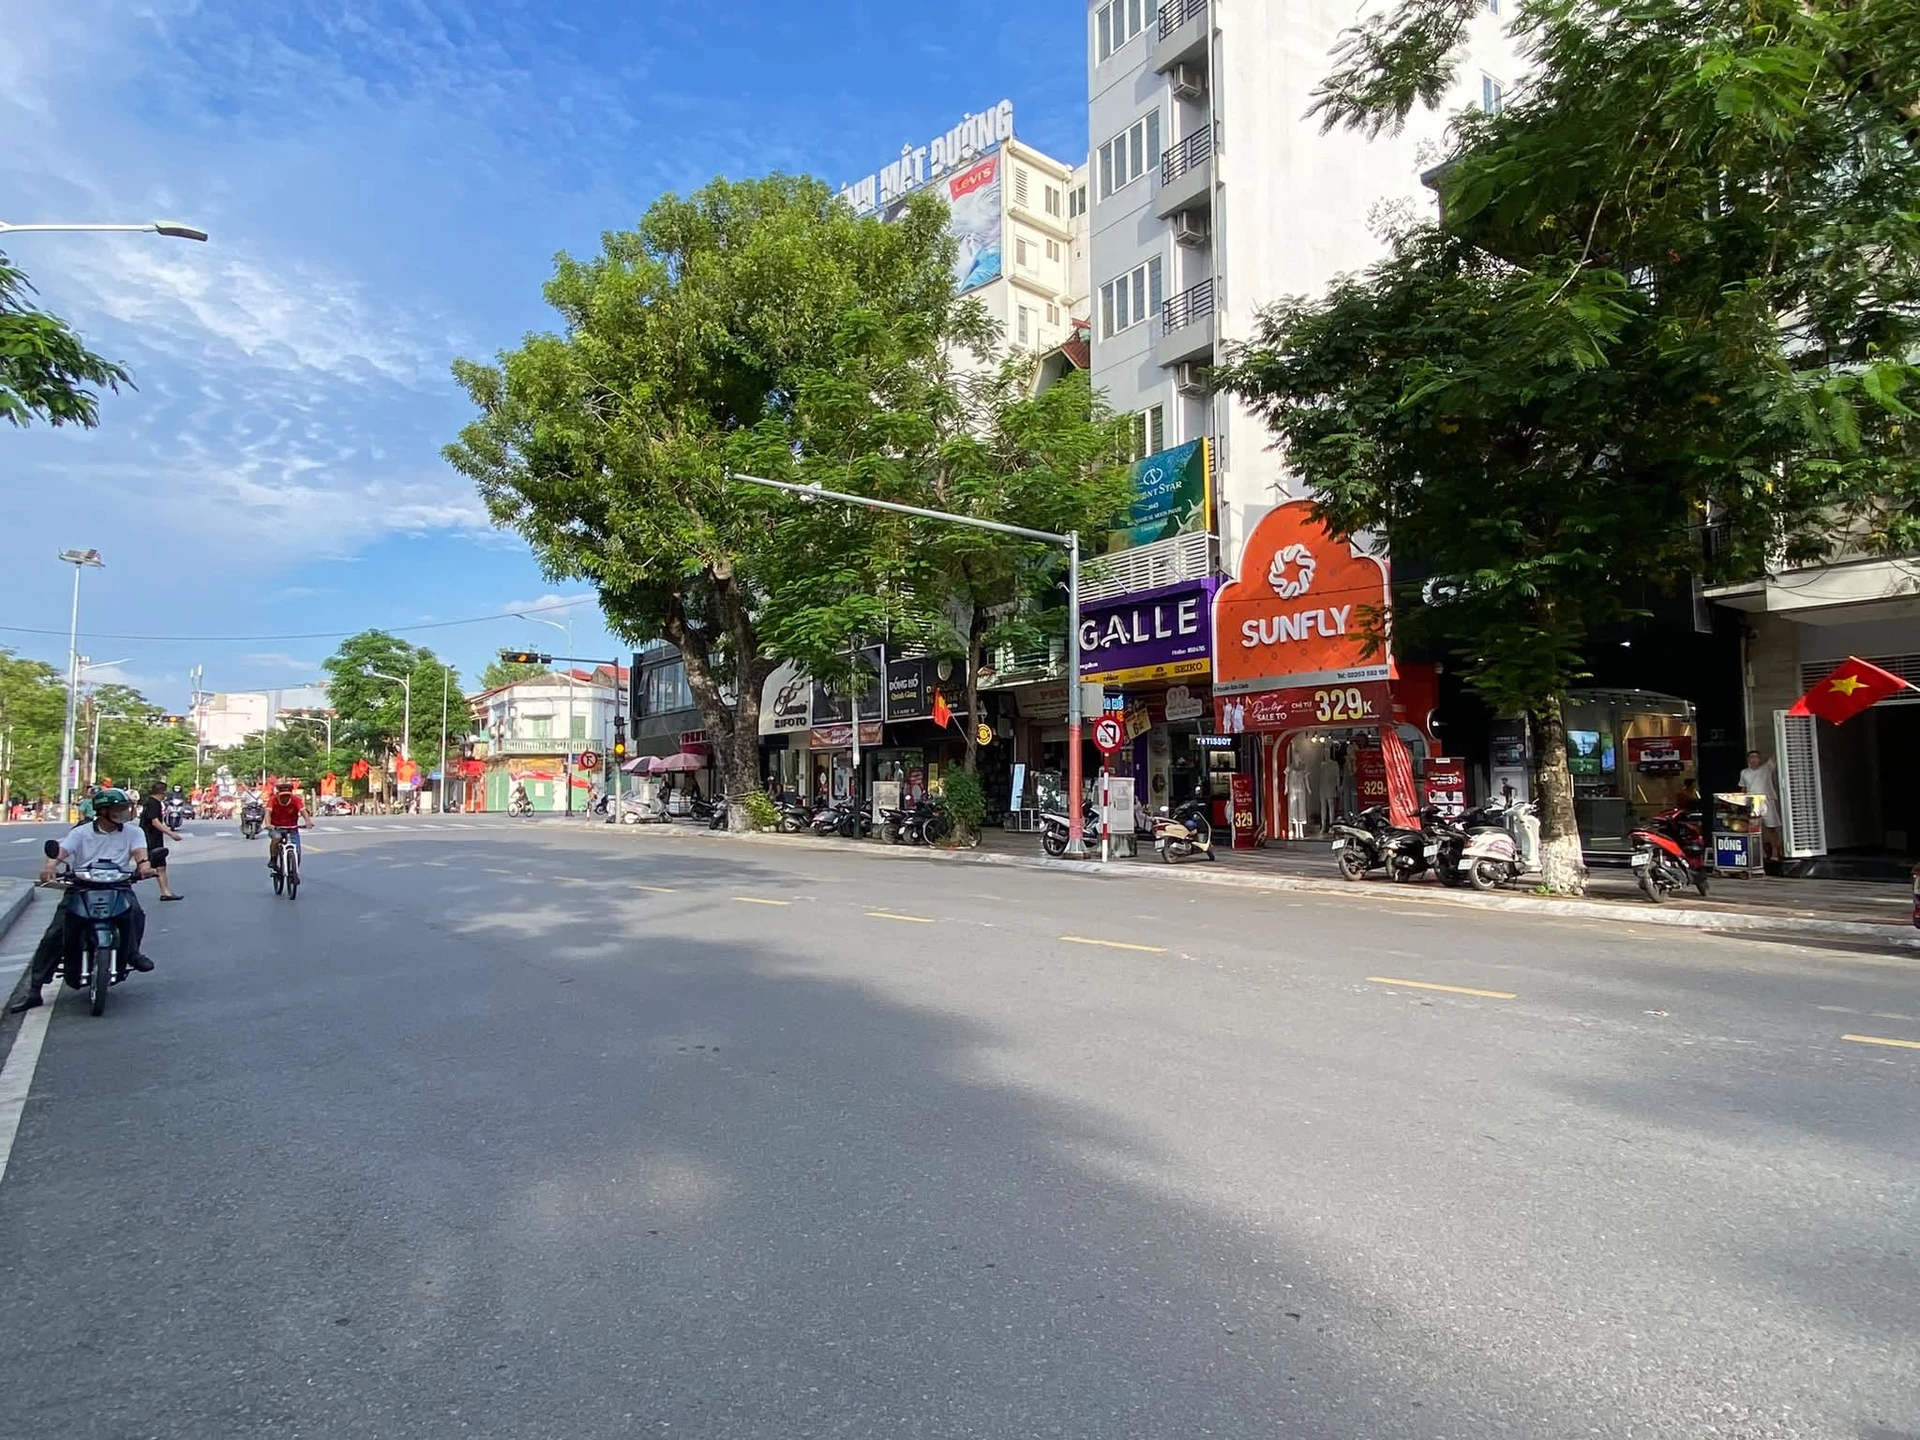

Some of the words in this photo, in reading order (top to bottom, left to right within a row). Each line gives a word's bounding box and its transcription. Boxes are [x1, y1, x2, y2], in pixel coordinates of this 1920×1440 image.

[1079, 598, 1199, 651] GALLE
[1241, 604, 1350, 648] SUNFLY
[1174, 662, 1203, 673] SEIKO
[1257, 713, 1275, 721] SALE
[1275, 712, 1287, 720] TO
[1235, 811, 1253, 828] 329
